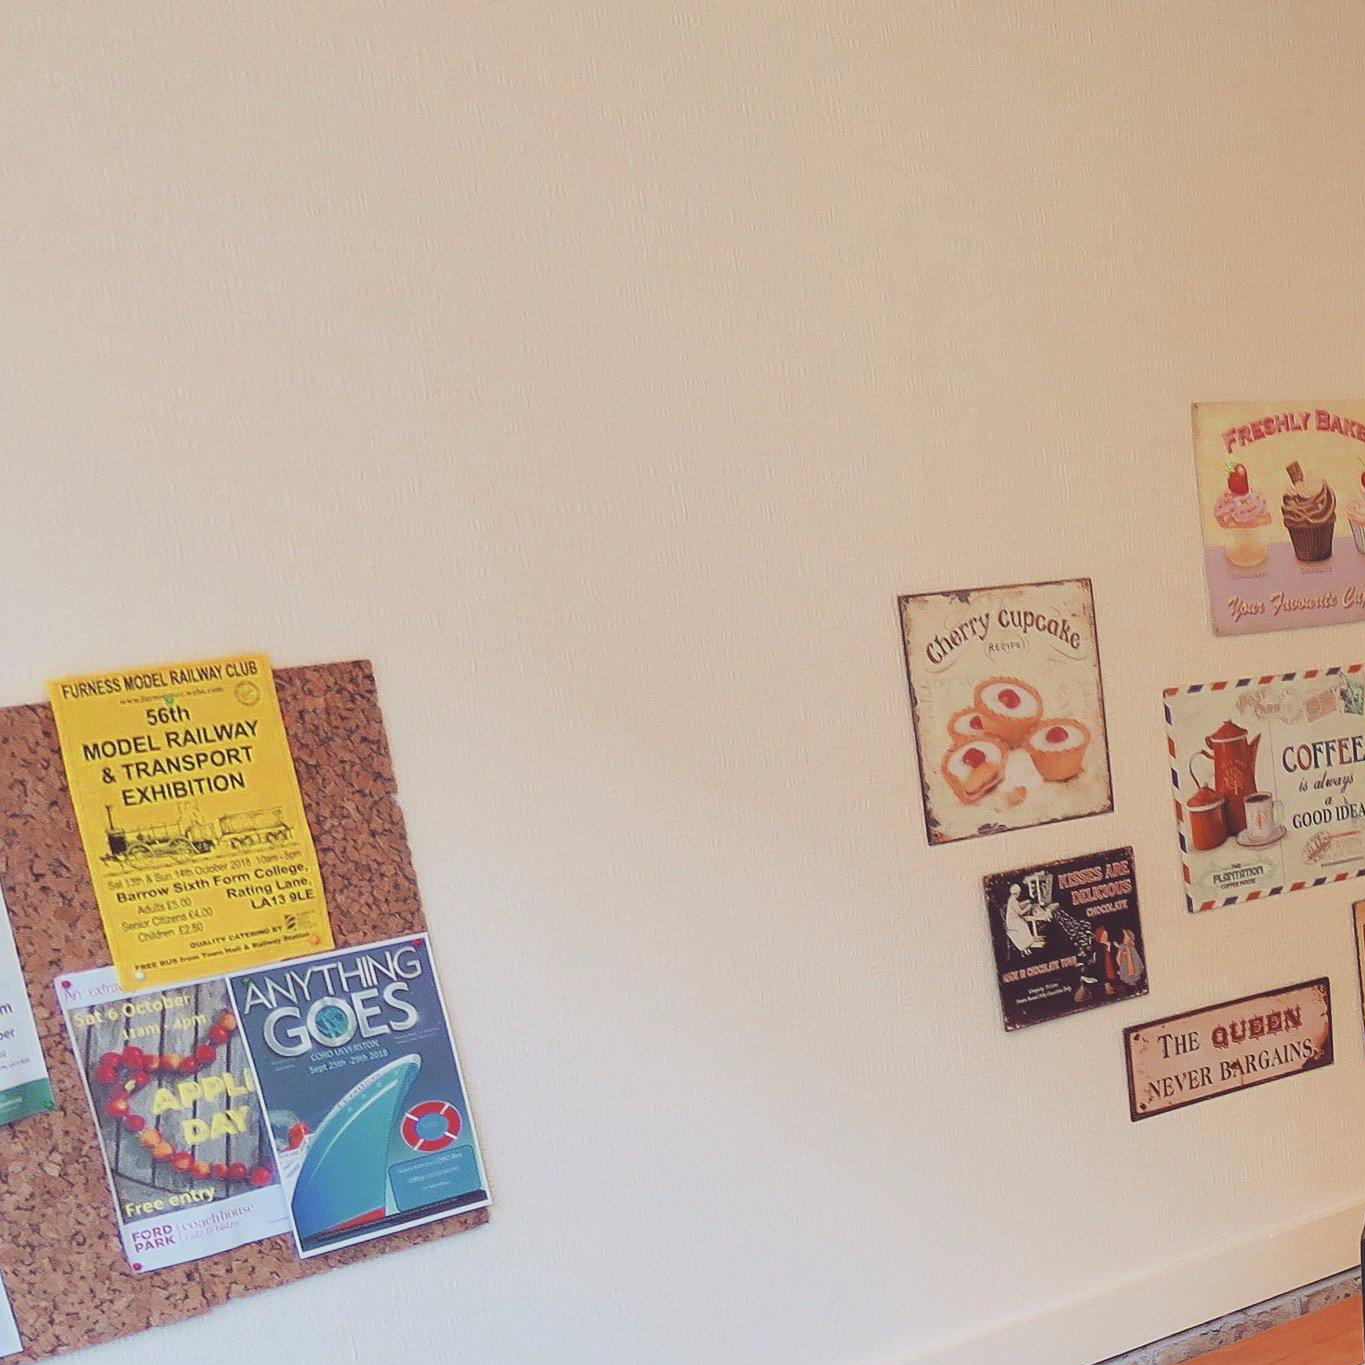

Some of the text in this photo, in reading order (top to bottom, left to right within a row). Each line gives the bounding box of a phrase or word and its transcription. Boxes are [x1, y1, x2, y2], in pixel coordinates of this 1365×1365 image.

[1221, 411, 1311, 454] FRESHLY
[1228, 595, 1266, 623] Your
[1270, 591, 1338, 618] Favourite
[925, 611, 992, 665] Cherry
[61, 661, 258, 699] FURNESS MODEL RAILWAY CLUB
[146, 705, 190, 726] 56th
[82, 720, 259, 760] MODEL RAILWAY
[102, 746, 253, 784] & TRANSPORT
[122, 772, 245, 806] EXHIBITION
[1299, 771, 1355, 795] is always
[1324, 796, 1333, 806] a
[1292, 808, 1332, 830] GOOD
[116, 863, 309, 903] Barrow Sixth Form College,
[226, 877, 312, 899] Rating Lane,
[1057, 860, 1131, 890] KISSES ARE
[251, 889, 315, 909] LA13 9LE
[1070, 878, 1134, 906] DELICIOUS
[244, 946, 423, 1014] ANYTHING
[107, 1007, 118, 1020] 6
[121, 995, 190, 1017] October
[263, 981, 419, 1057] GOES
[1158, 1004, 1302, 1059] THE QUEEN
[1148, 1038, 1313, 1102] NEVER BARGAINS
[182, 1105, 250, 1146] DAY
[125, 1186, 215, 1217] Free entry
[132, 1224, 173, 1243] FORD
[134, 1235, 176, 1253] PARK
